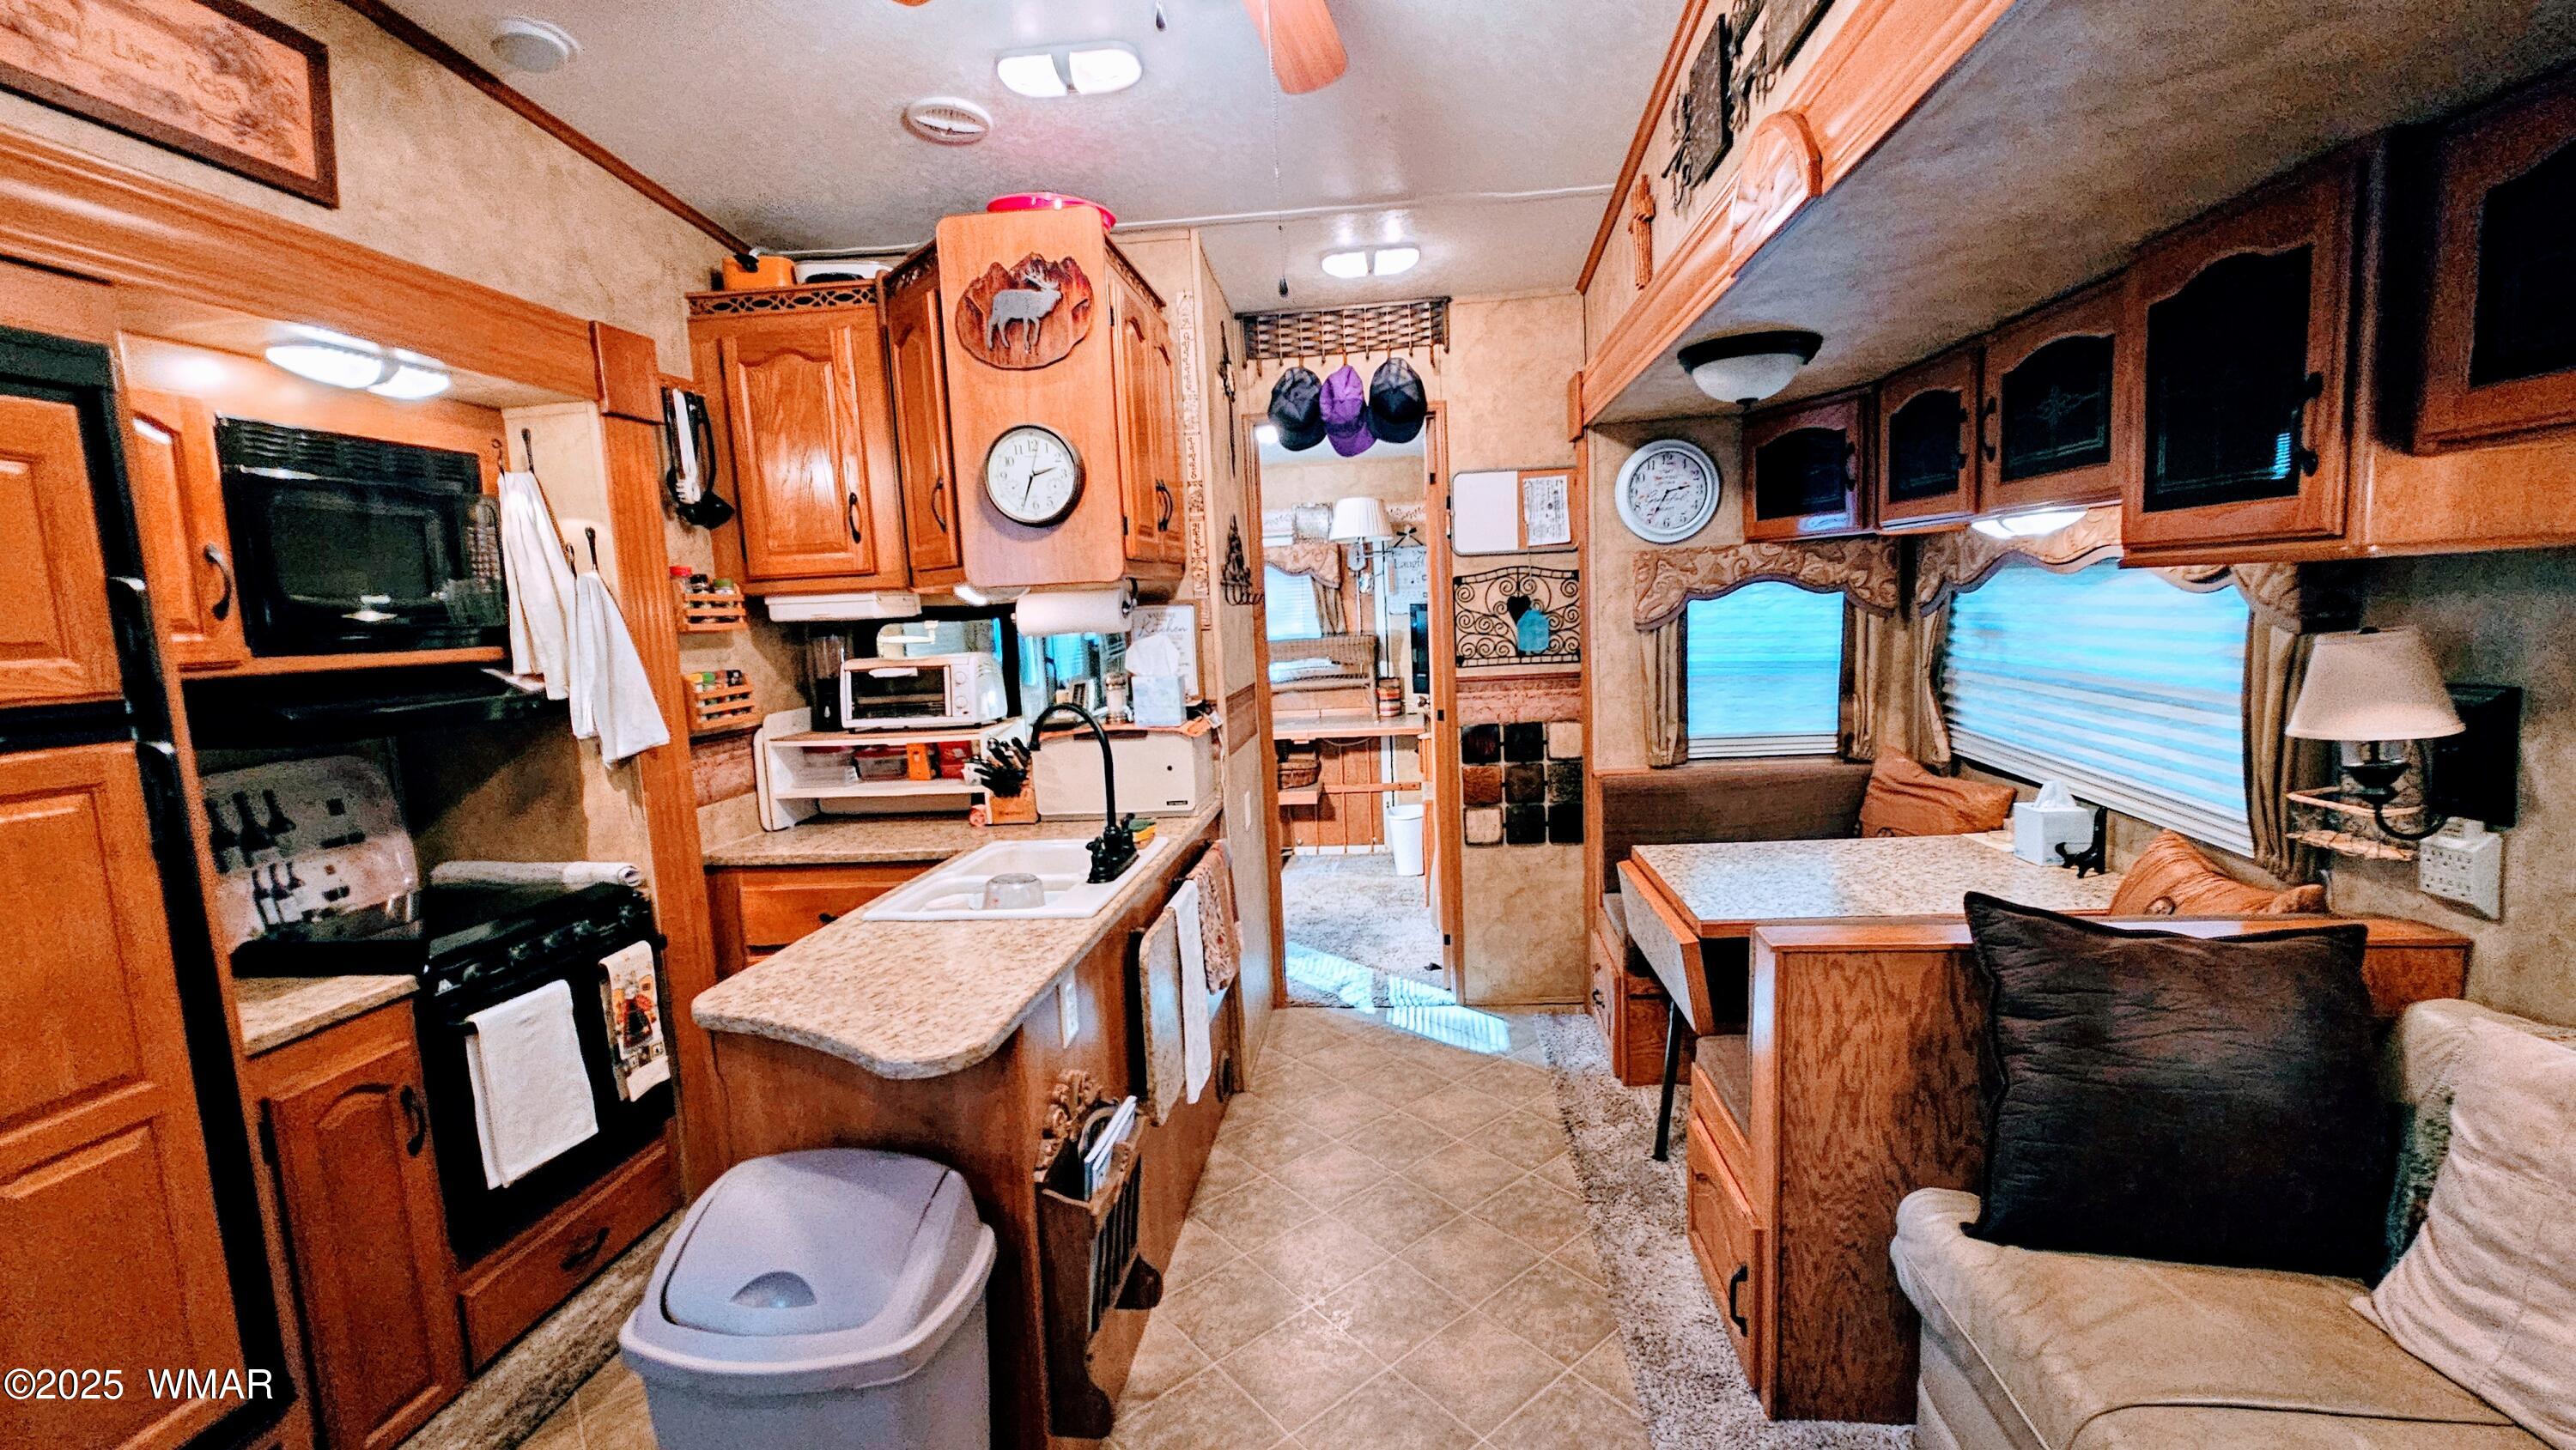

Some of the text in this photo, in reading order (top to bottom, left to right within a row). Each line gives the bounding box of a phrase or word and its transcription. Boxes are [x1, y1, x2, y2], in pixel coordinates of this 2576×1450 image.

[1013, 445, 1024, 455] 11
[1028, 440, 1038, 452] 12
[1045, 442, 1048, 454] 1
[1005, 456, 1015, 467] 10
[1054, 452, 1062, 463] 2
[1662, 453, 1675, 465] 12
[1647, 460, 1655, 470] 11
[1000, 472, 1007, 481] 9
[1061, 469, 1067, 478] 3
[1635, 473, 1645, 484] 10
[1695, 484, 1704, 494] 3
[1033, 501, 1039, 510] 6
[1663, 518, 1669, 527] 6
[1138, 616, 1189, 637] Kitchen
